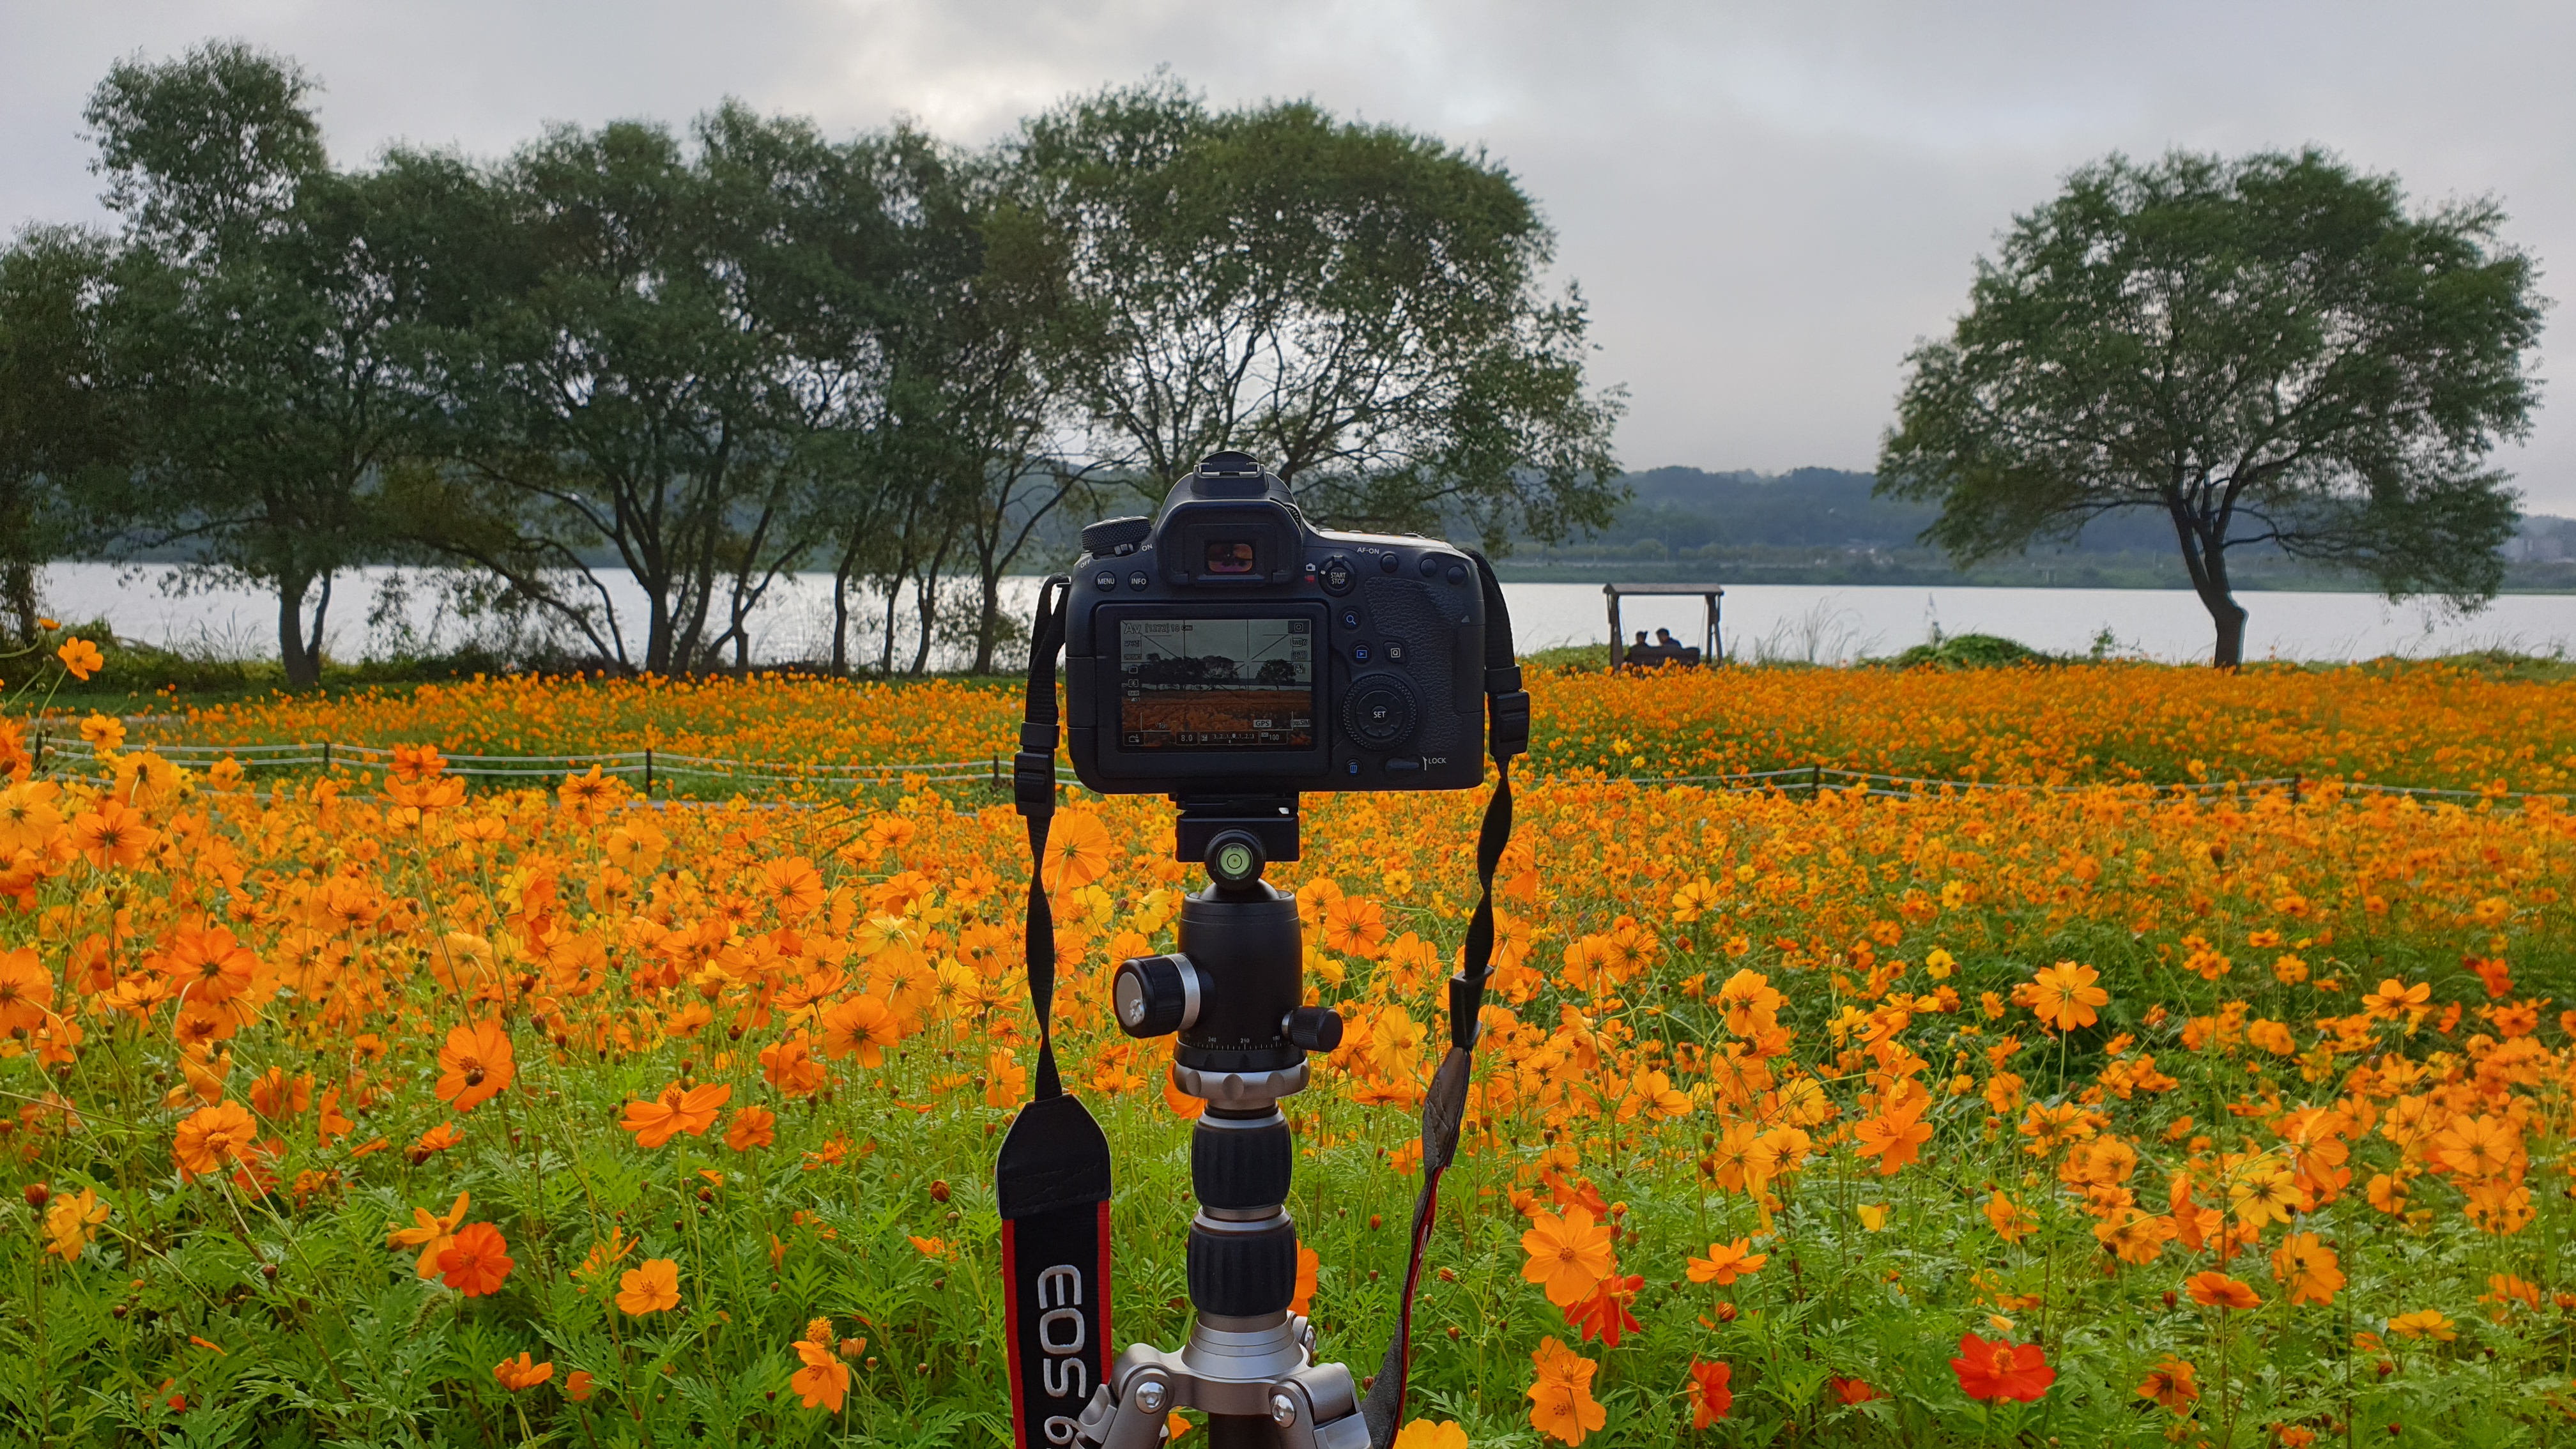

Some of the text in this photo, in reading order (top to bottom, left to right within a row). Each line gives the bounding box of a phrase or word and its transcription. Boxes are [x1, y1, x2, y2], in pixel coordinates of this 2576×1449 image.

[1142, 543, 1153, 552] ON
[1357, 546, 1380, 555] AF-ON
[1080, 559, 1091, 569] OFF
[1098, 577, 1115, 585] MENU
[1131, 577, 1147, 585] INFO
[1124, 623, 1141, 634] Av
[1373, 710, 1385, 719] SET
[1038, 1264, 1087, 1449] EOS 6
